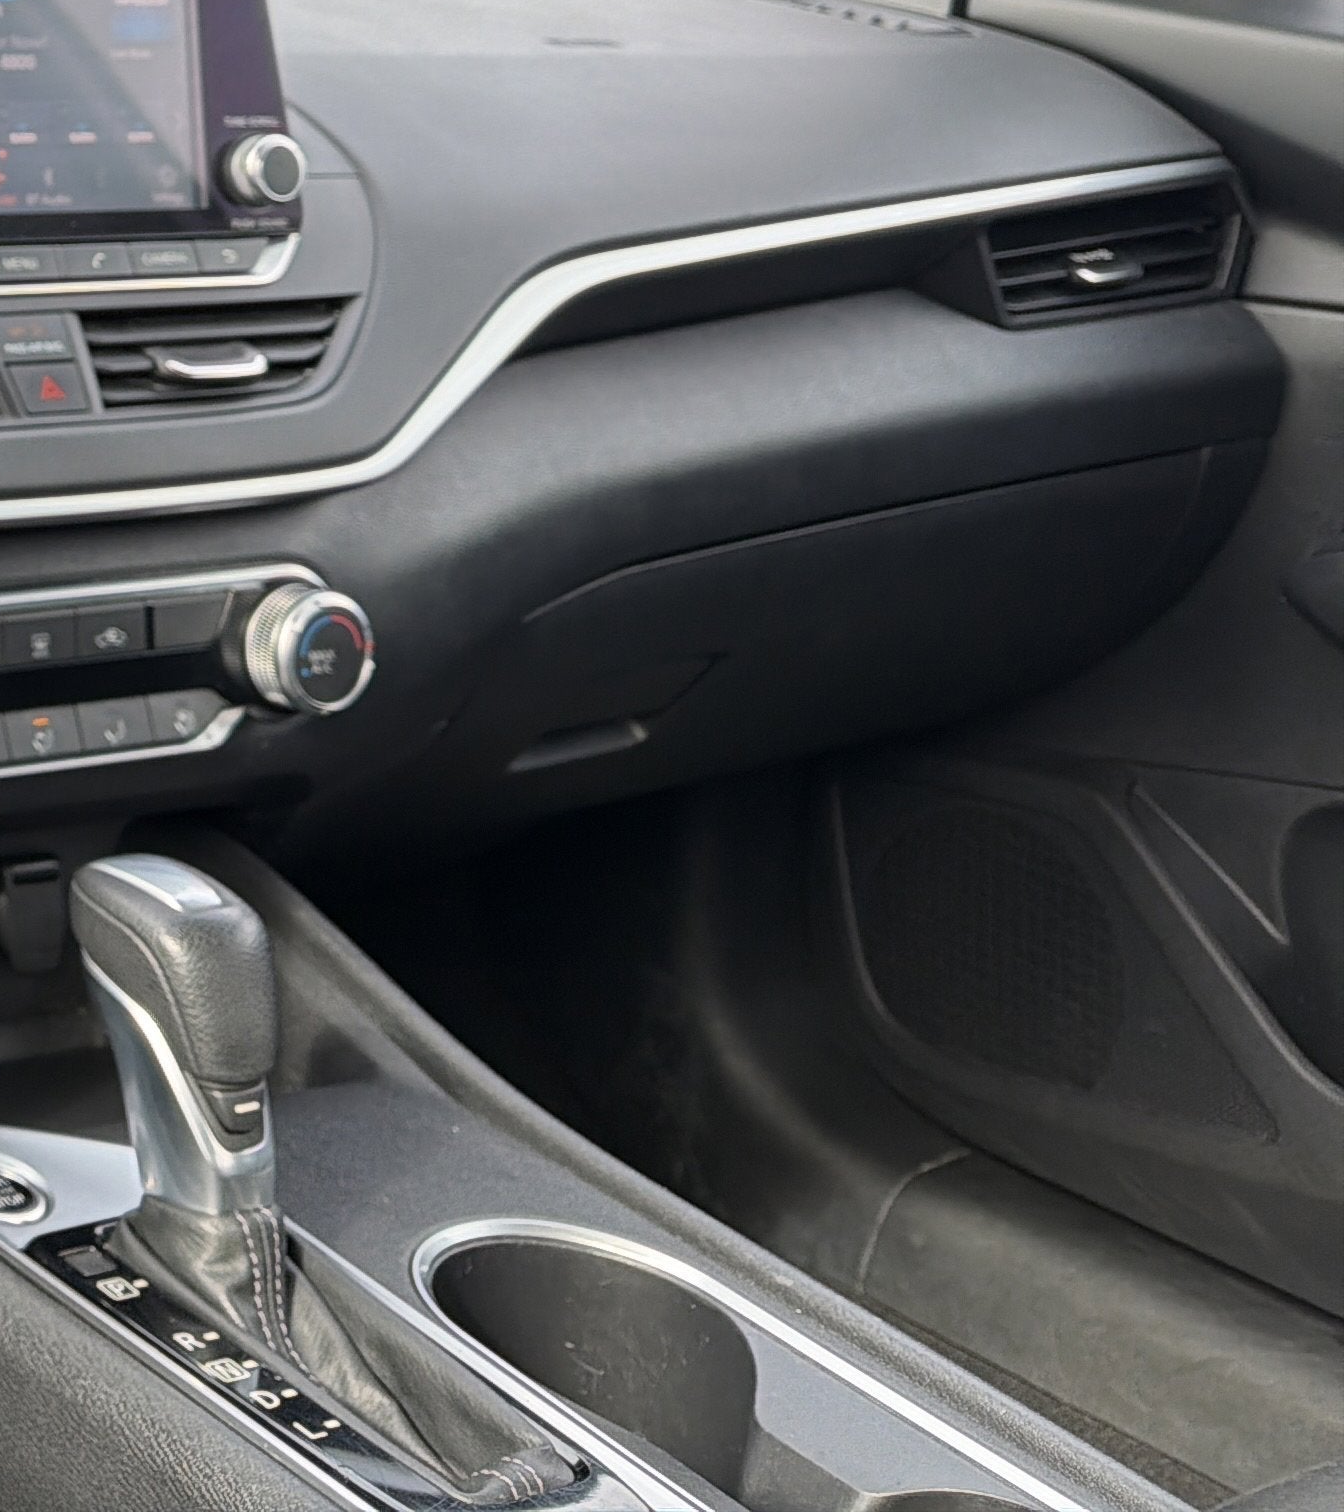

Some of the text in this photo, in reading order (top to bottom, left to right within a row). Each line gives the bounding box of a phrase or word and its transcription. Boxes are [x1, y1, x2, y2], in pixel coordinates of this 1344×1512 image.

[172, 1331, 207, 1352] R
[249, 1390, 281, 1410] D
[292, 1421, 329, 1440] L
